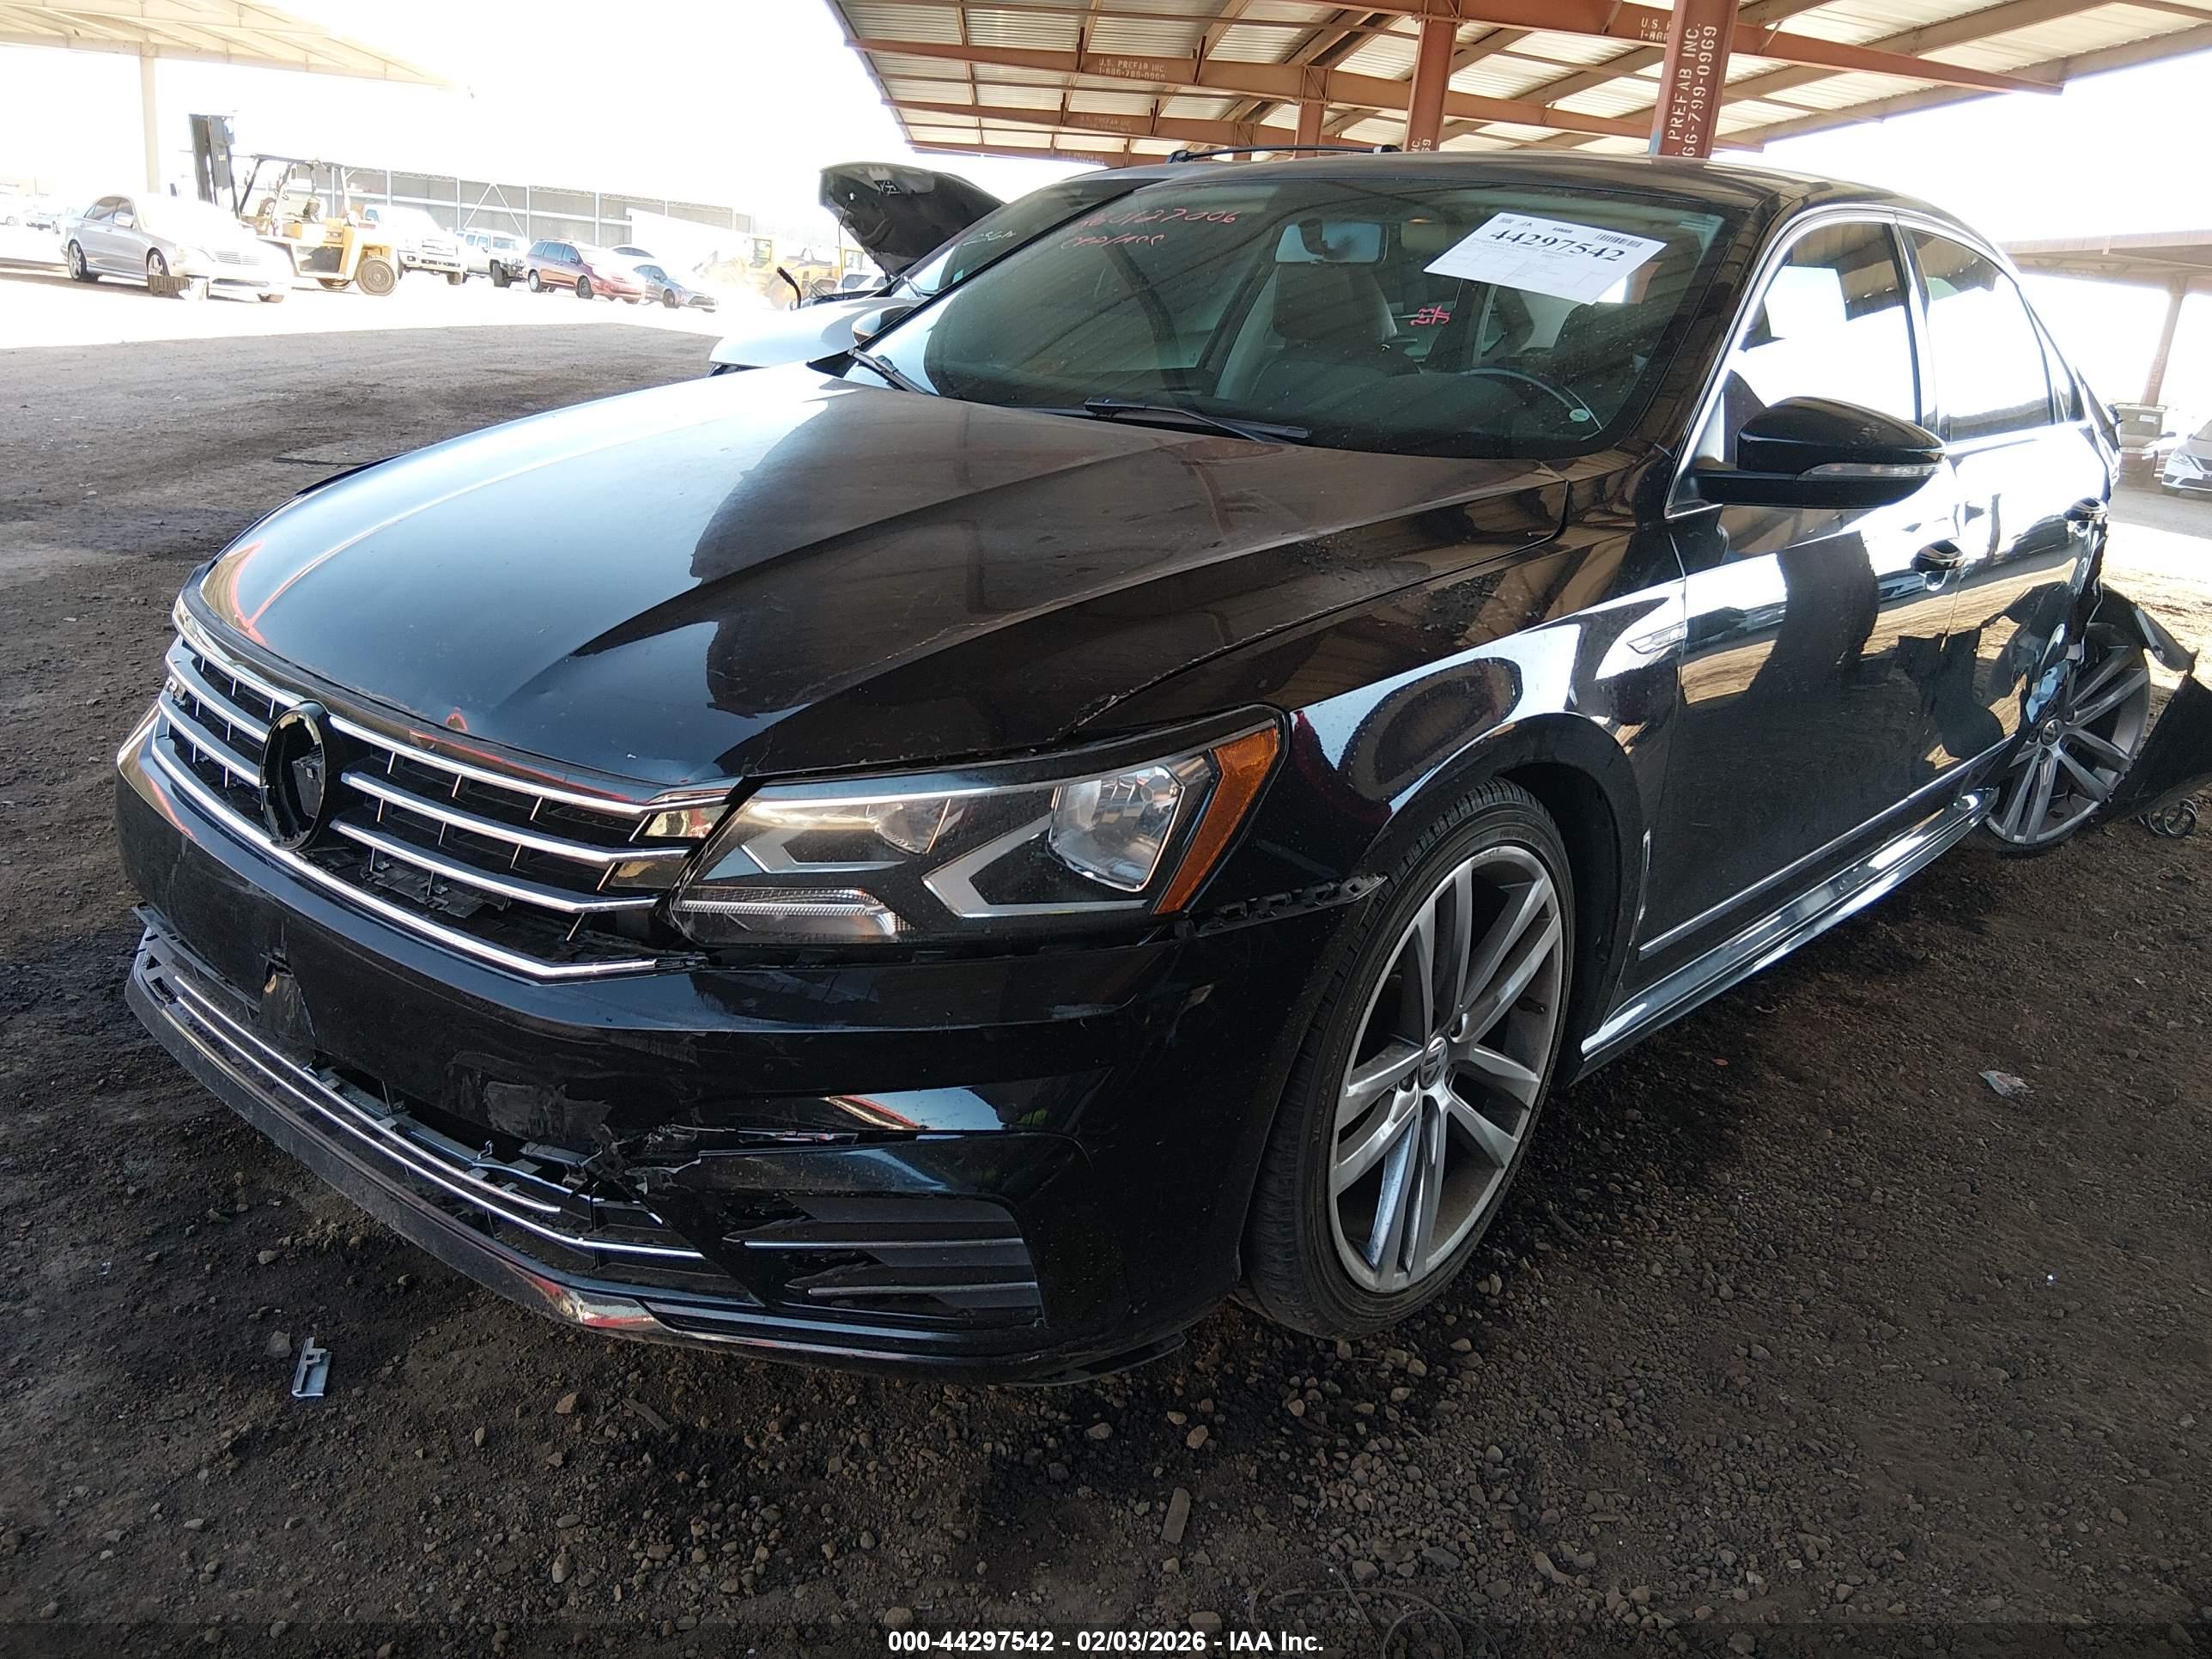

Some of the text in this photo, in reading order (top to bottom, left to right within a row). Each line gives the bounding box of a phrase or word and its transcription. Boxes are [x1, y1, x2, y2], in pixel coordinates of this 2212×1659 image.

[1640, 17, 1662, 31] U.S.
[1668, 22, 1702, 141] PREFAB INC.
[1490, 229, 1626, 262] 44297542
